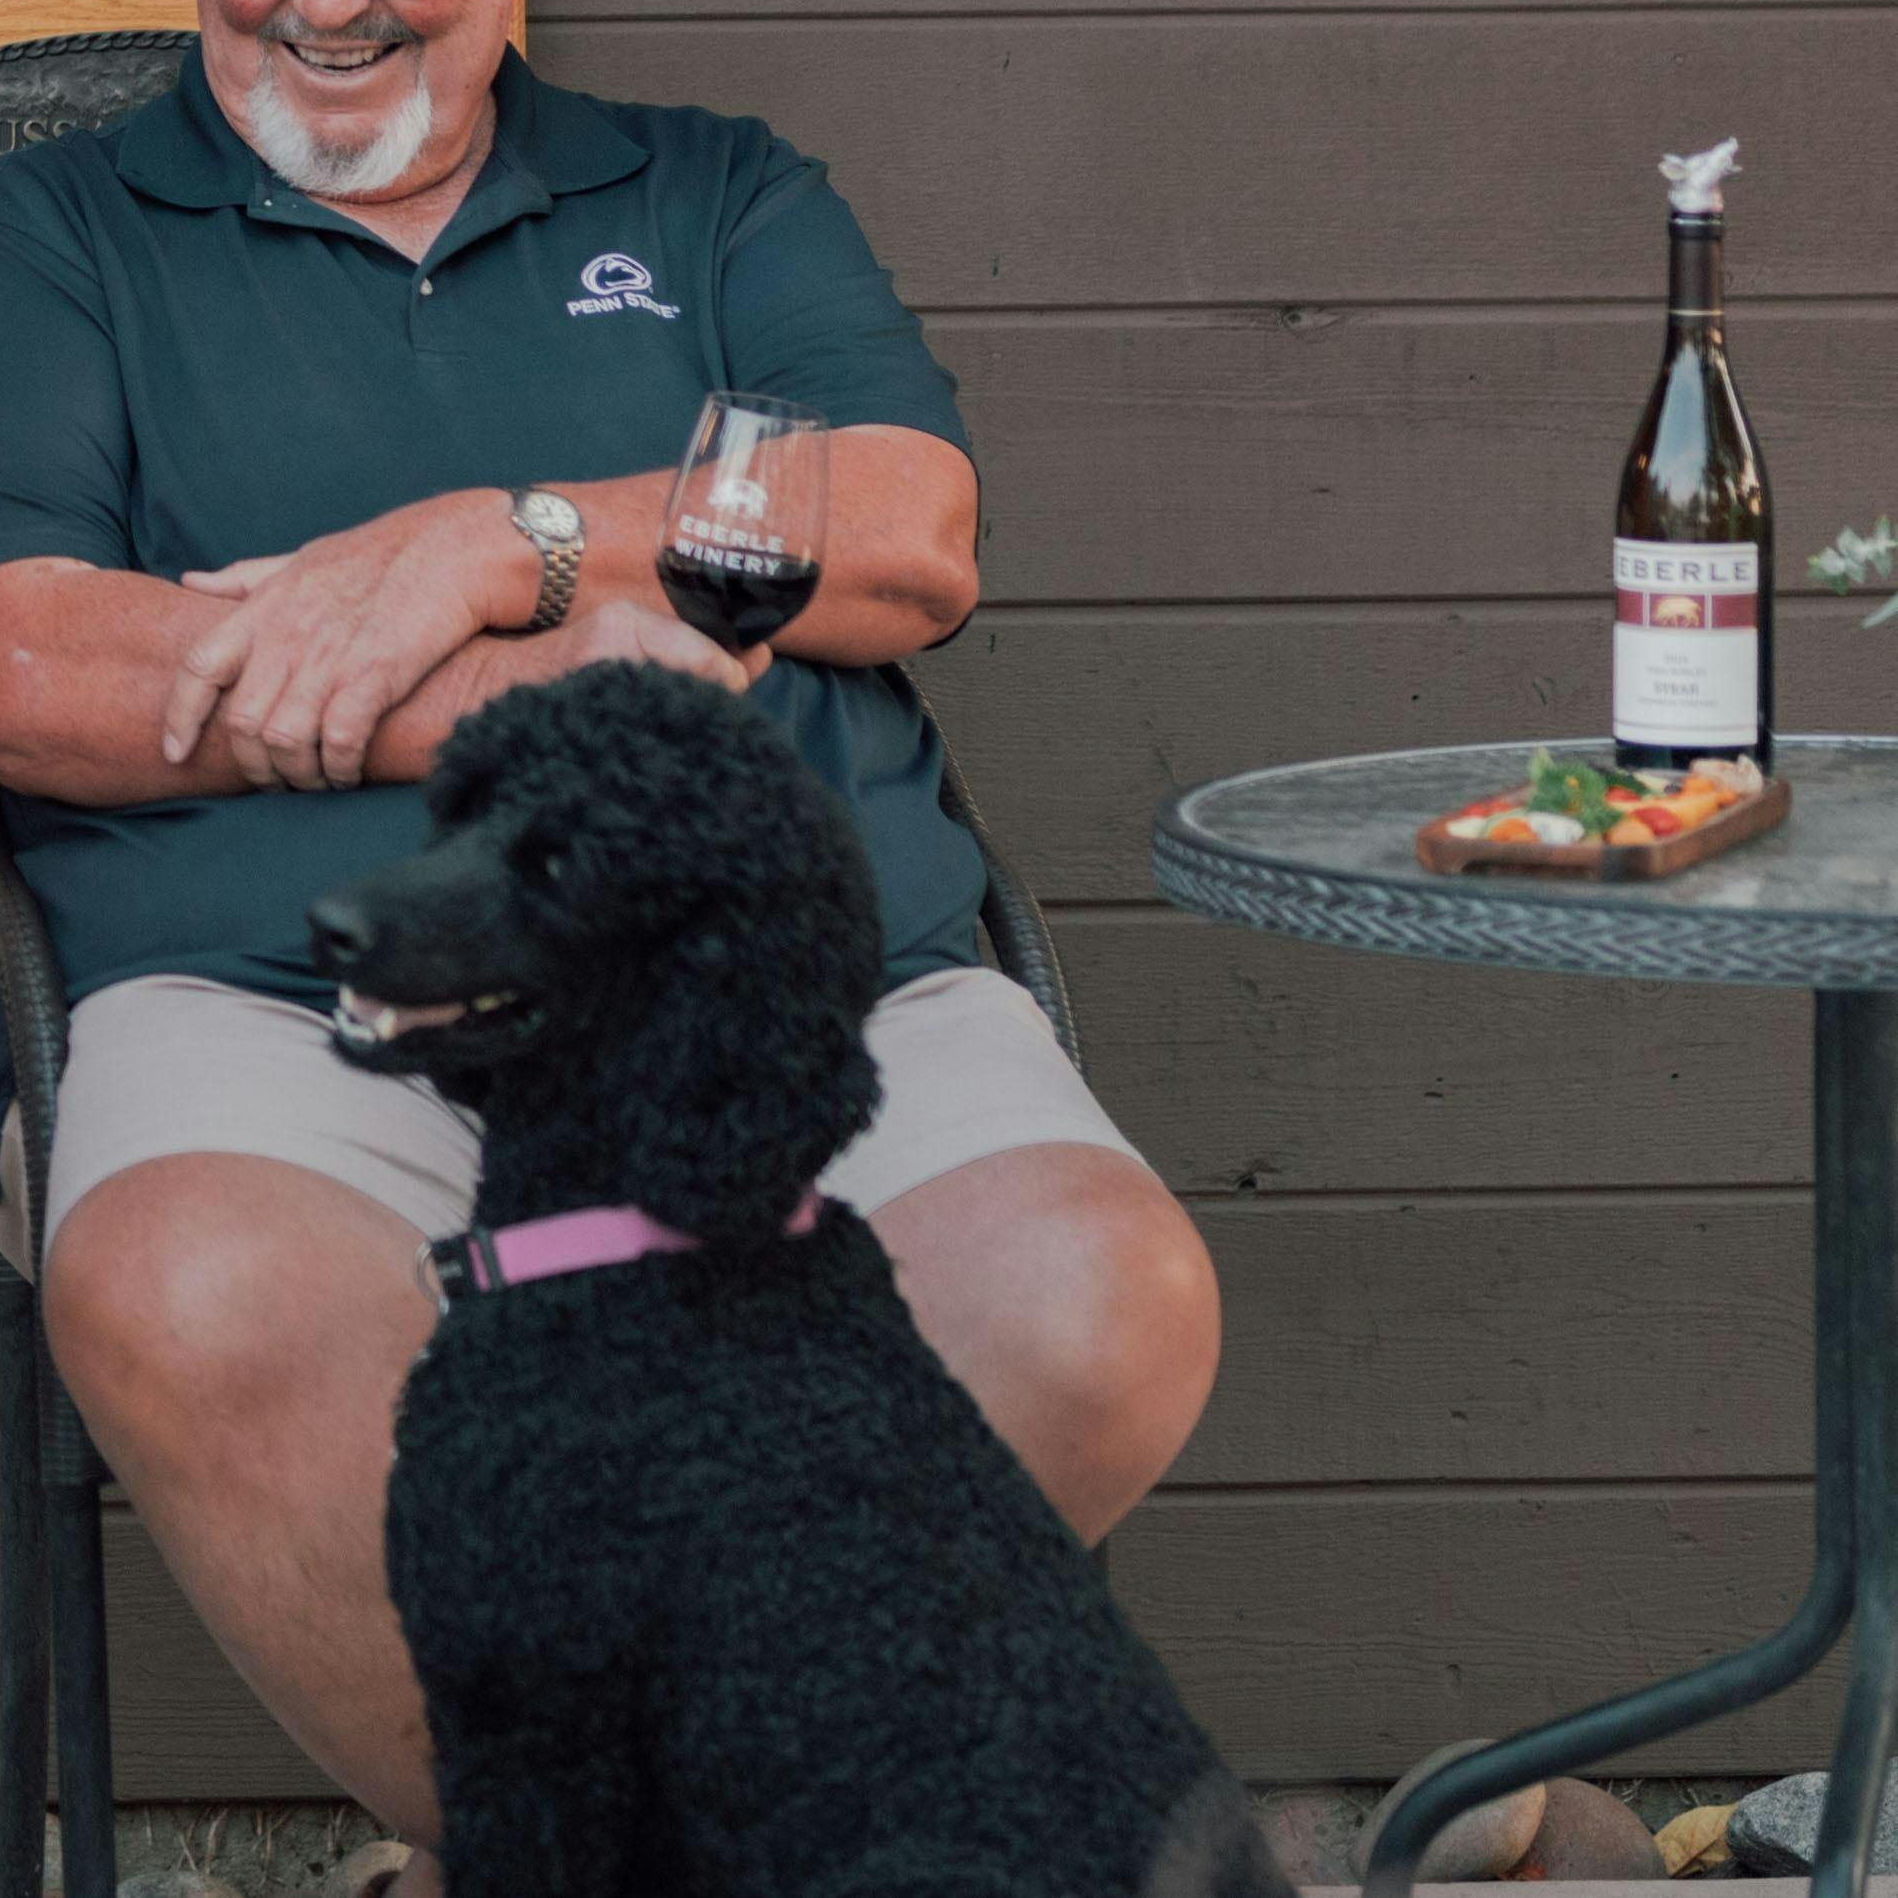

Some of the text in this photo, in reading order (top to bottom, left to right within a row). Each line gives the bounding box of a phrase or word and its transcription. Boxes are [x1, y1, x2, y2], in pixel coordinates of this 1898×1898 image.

[566, 291, 677, 319] PENN STATE
[679, 513, 784, 554] EBERLE
[674, 538, 782, 577] WINERY
[1618, 556, 1752, 583] EBERLE
